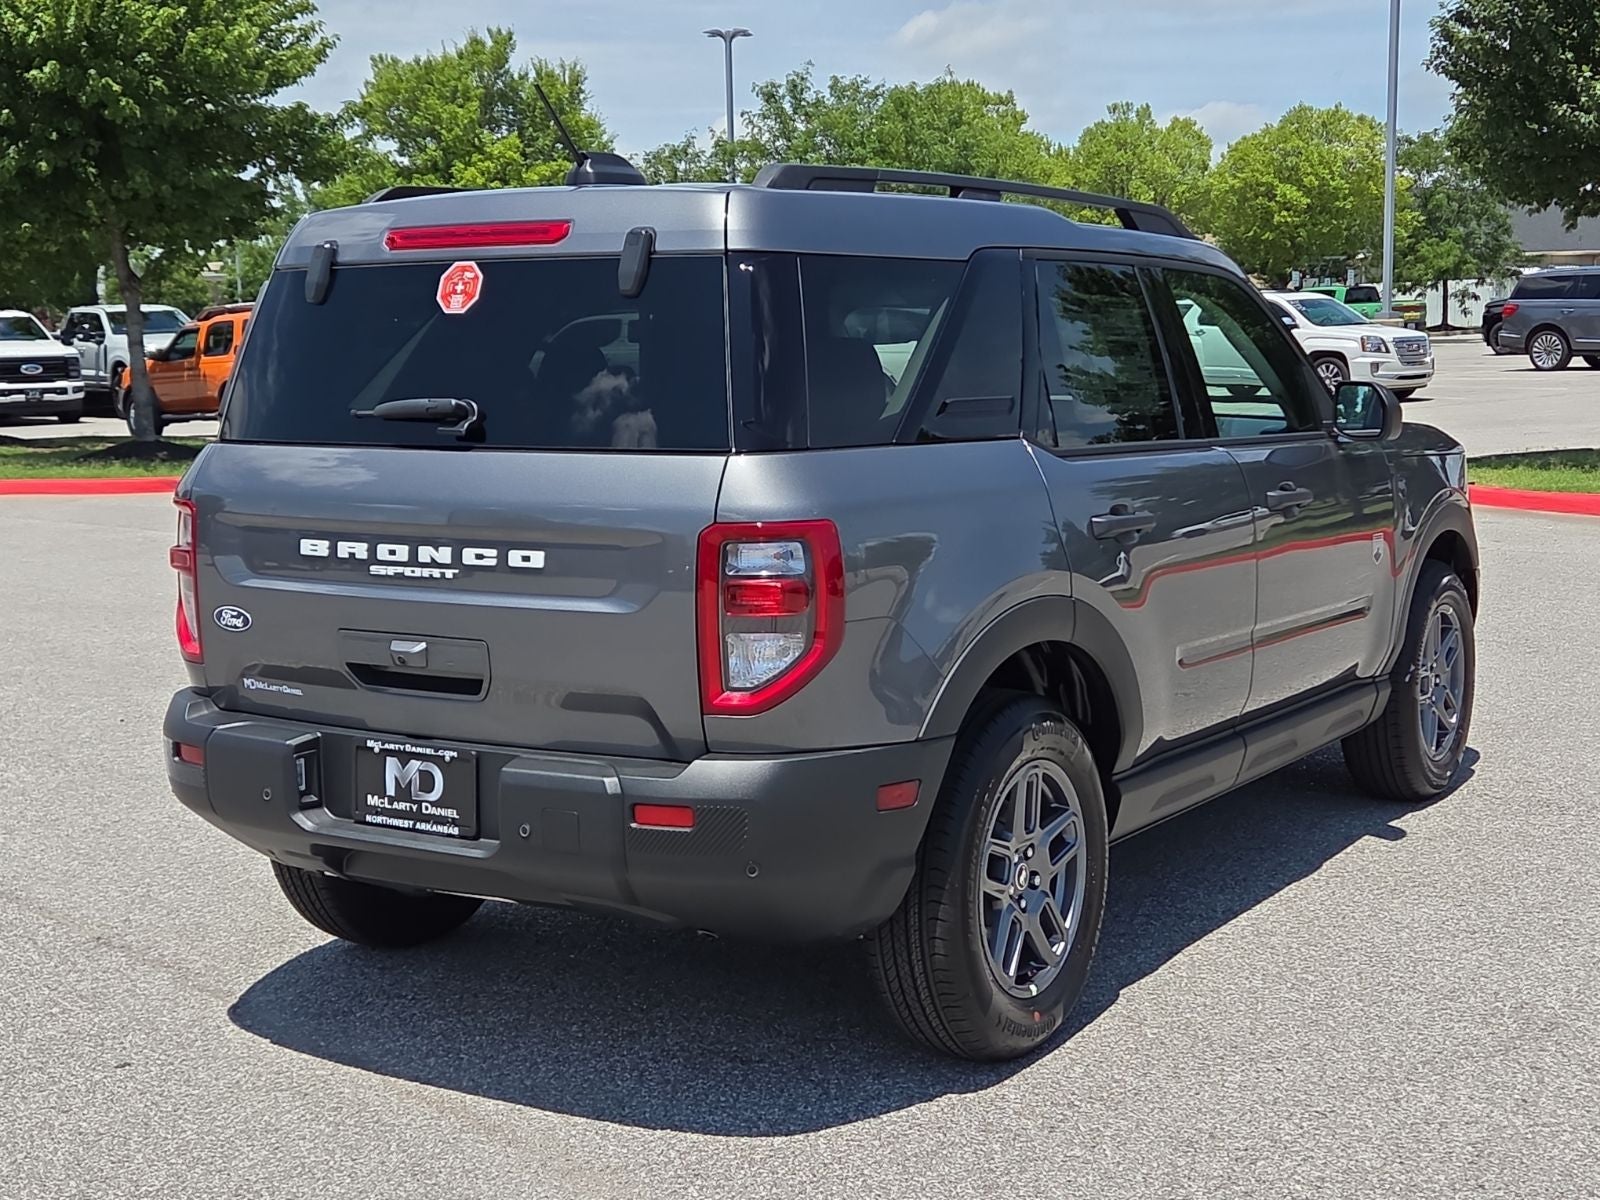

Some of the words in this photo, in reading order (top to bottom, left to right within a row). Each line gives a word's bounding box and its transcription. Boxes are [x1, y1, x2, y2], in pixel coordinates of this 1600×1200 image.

[299, 538, 546, 569] BRONCO
[369, 565, 459, 579] SPORT
[219, 608, 245, 628] Ford
[385, 756, 444, 802] MD
[365, 814, 414, 829] NORTHWEST
[415, 822, 459, 836] ARKANSAS
